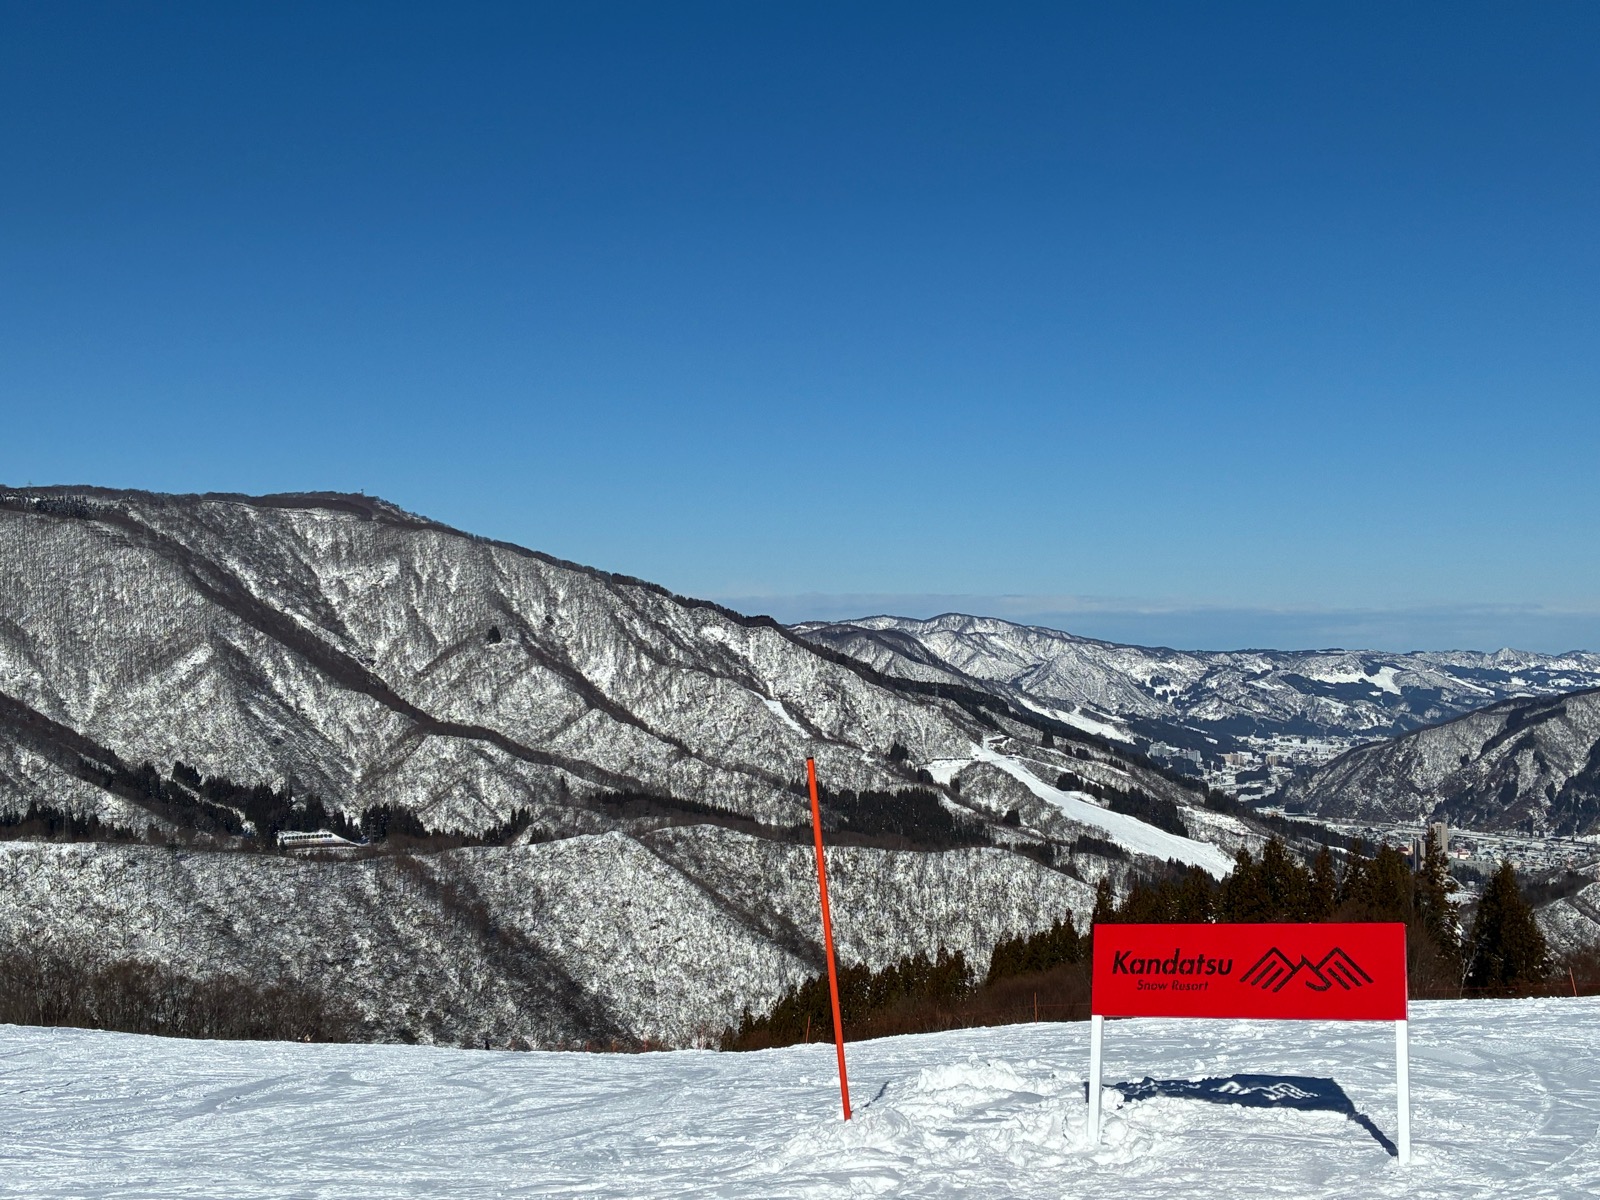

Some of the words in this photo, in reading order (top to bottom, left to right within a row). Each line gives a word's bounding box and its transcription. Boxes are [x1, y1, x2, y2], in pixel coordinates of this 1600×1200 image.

[1112, 948, 1234, 976] Kandatsu
[1136, 979, 1169, 991] Snow
[1171, 979, 1210, 992] Resort
